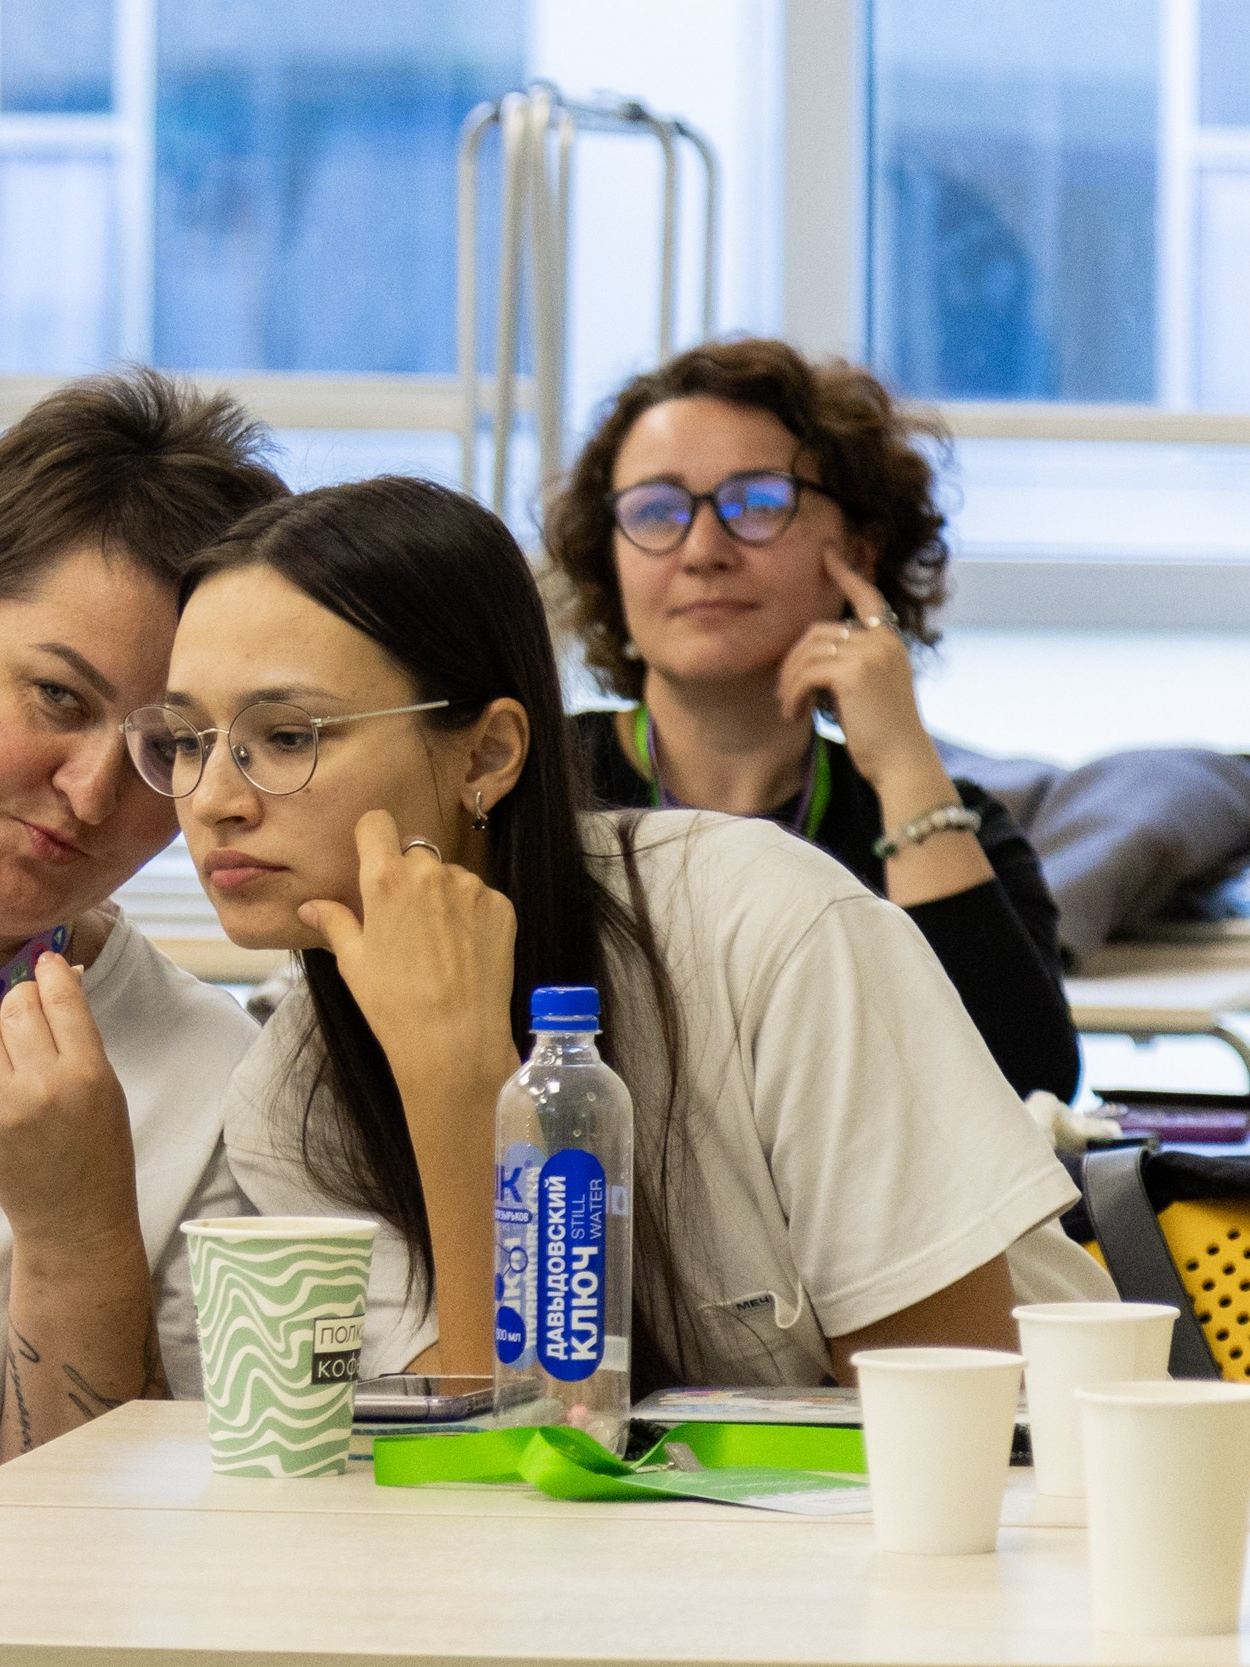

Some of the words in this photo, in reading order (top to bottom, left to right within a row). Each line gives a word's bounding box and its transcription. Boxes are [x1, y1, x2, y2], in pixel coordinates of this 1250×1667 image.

[571, 1194, 586, 1240] STILL
[589, 1178, 603, 1240] WATER
[544, 1175, 567, 1361] ДАВЫДОВСКИЙ
[571, 1245, 599, 1361] КЛЮЧ
